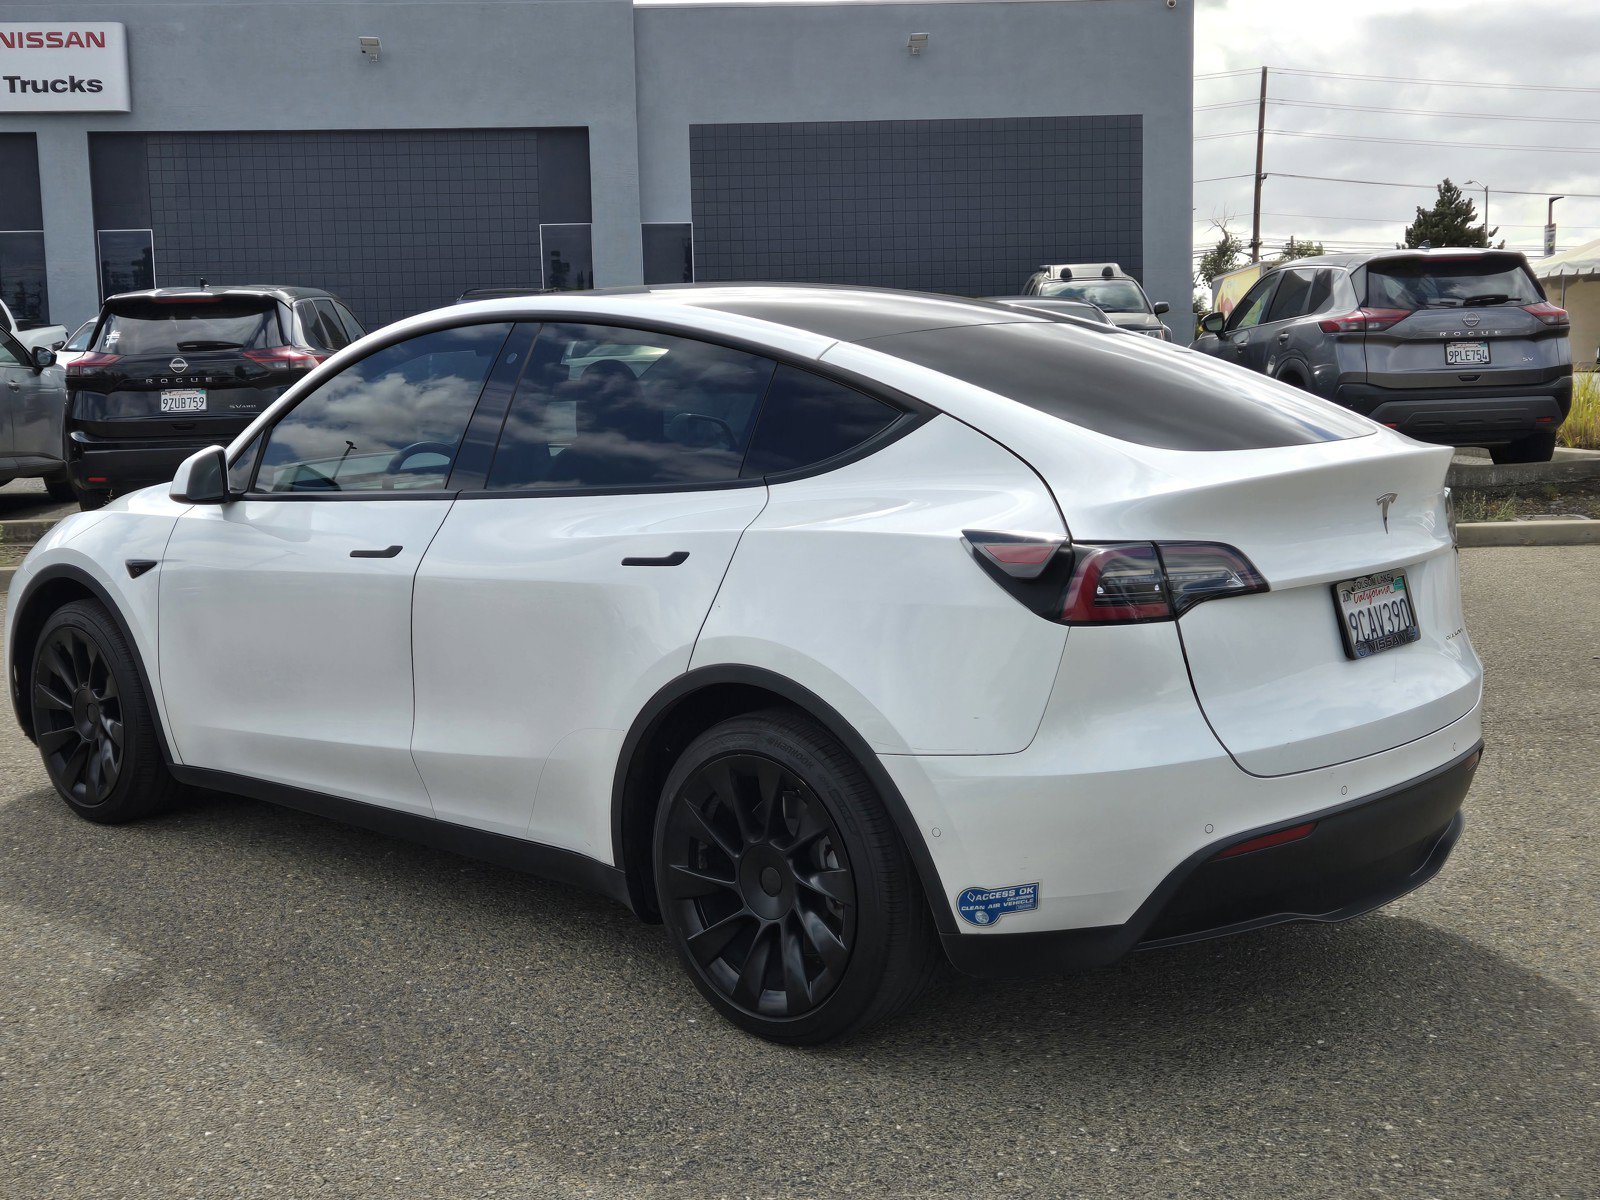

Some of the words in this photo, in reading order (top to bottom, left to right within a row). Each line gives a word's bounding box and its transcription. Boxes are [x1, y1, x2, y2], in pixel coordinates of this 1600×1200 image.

[0, 32, 105, 48] NISSAN
[3, 75, 103, 93] Trucks
[1448, 350, 1488, 361] 9PLE754
[162, 397, 205, 410] 9ZUB759
[1378, 573, 1391, 584] LAKE
[1349, 598, 1412, 645] 9CAV390
[975, 889, 1016, 901] ACCESS
[1019, 886, 1035, 895] OK
[1003, 899, 1034, 907] VEHICLE
